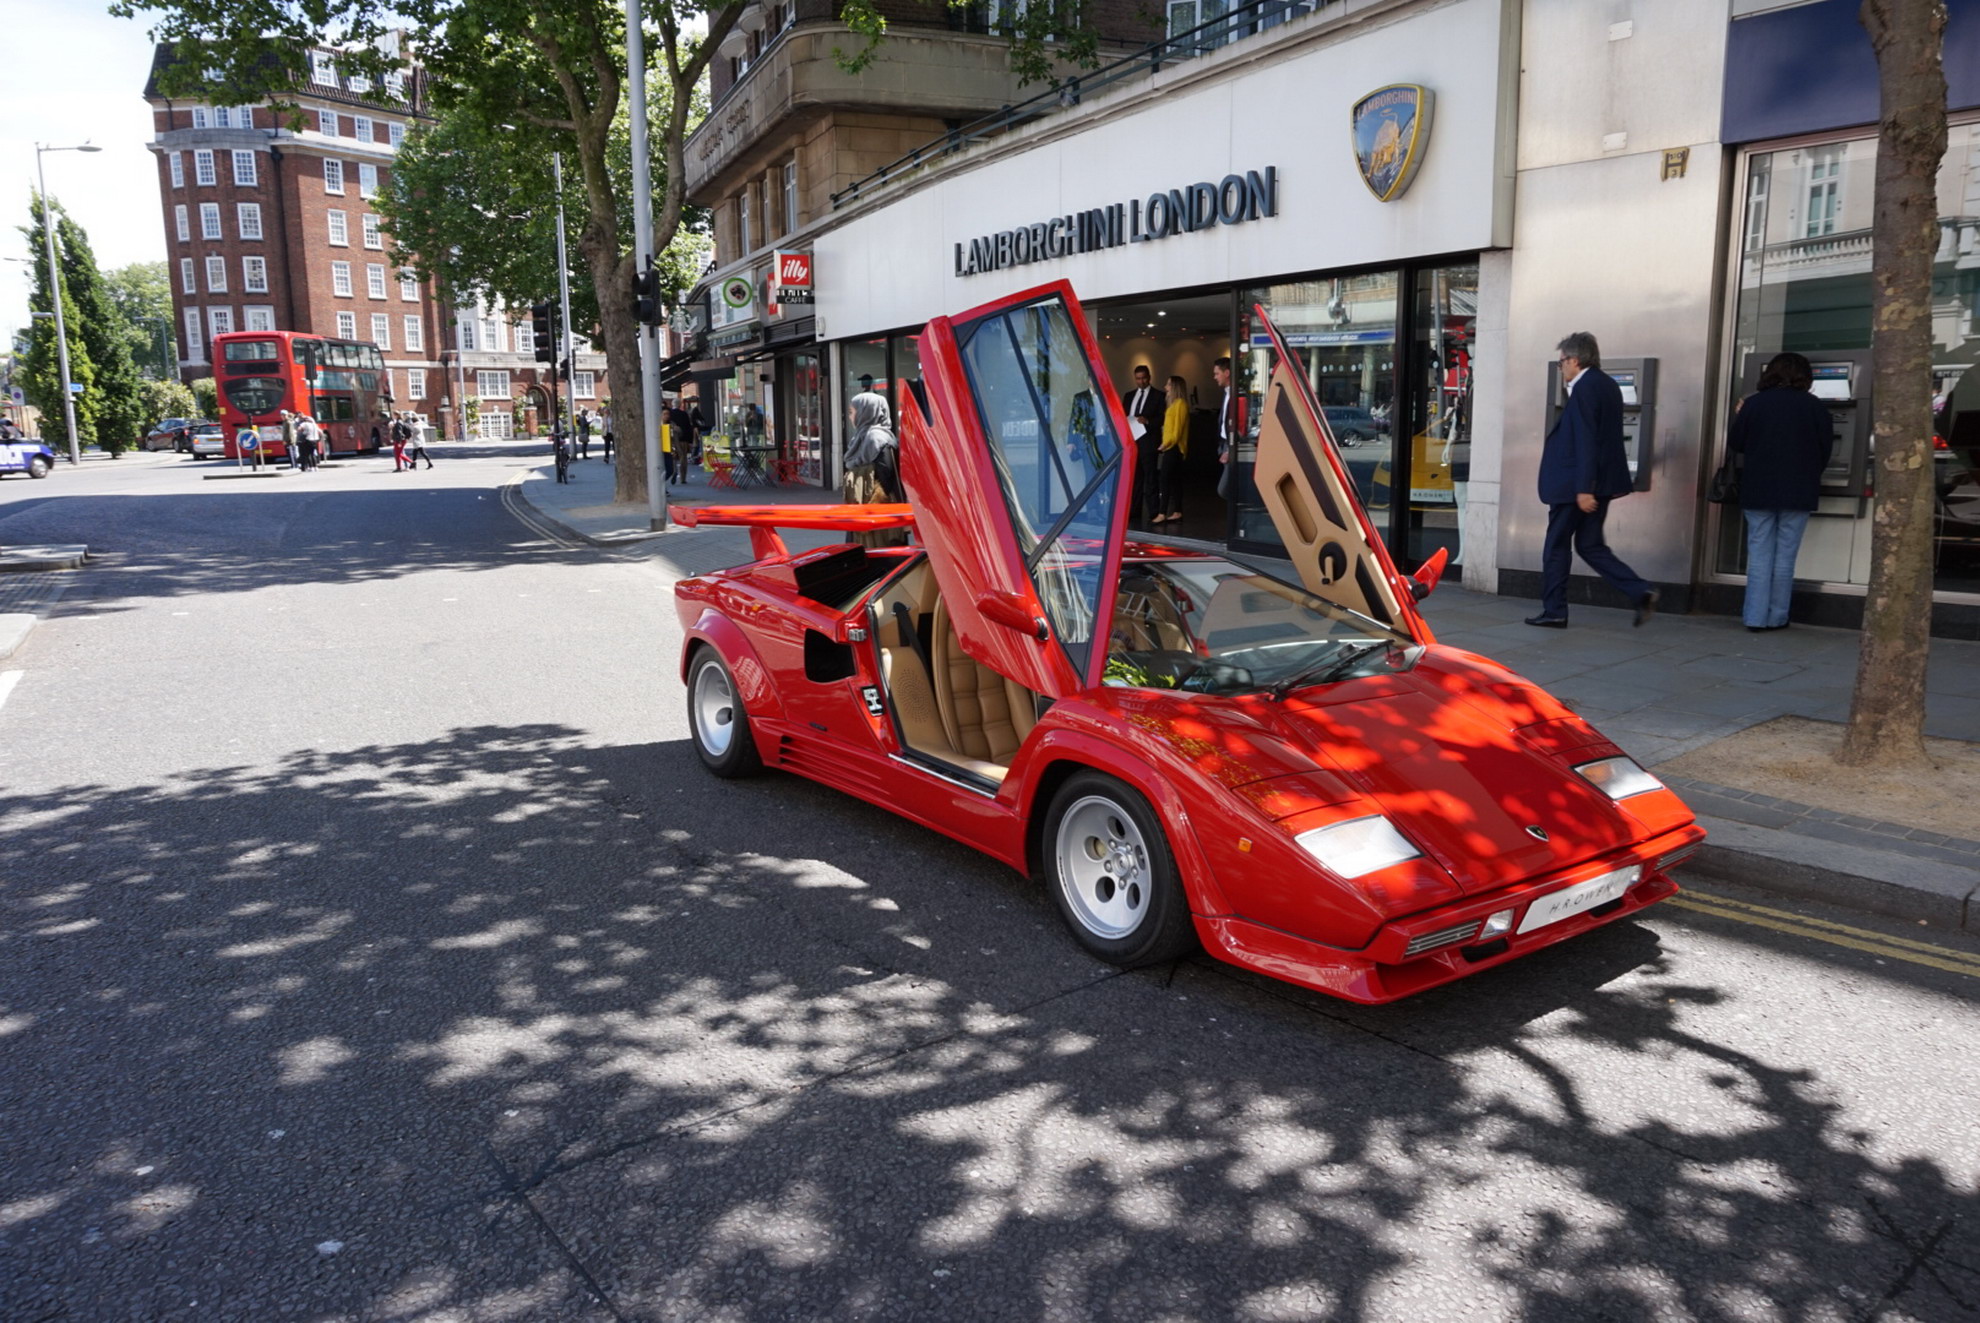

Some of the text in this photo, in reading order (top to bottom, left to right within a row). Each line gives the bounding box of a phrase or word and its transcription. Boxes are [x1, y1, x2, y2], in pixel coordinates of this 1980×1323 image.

[1357, 90, 1417, 120] LAMBORGHINI
[954, 166, 1277, 277] LAMBORGHINI LONDON
[782, 259, 808, 283] illy
